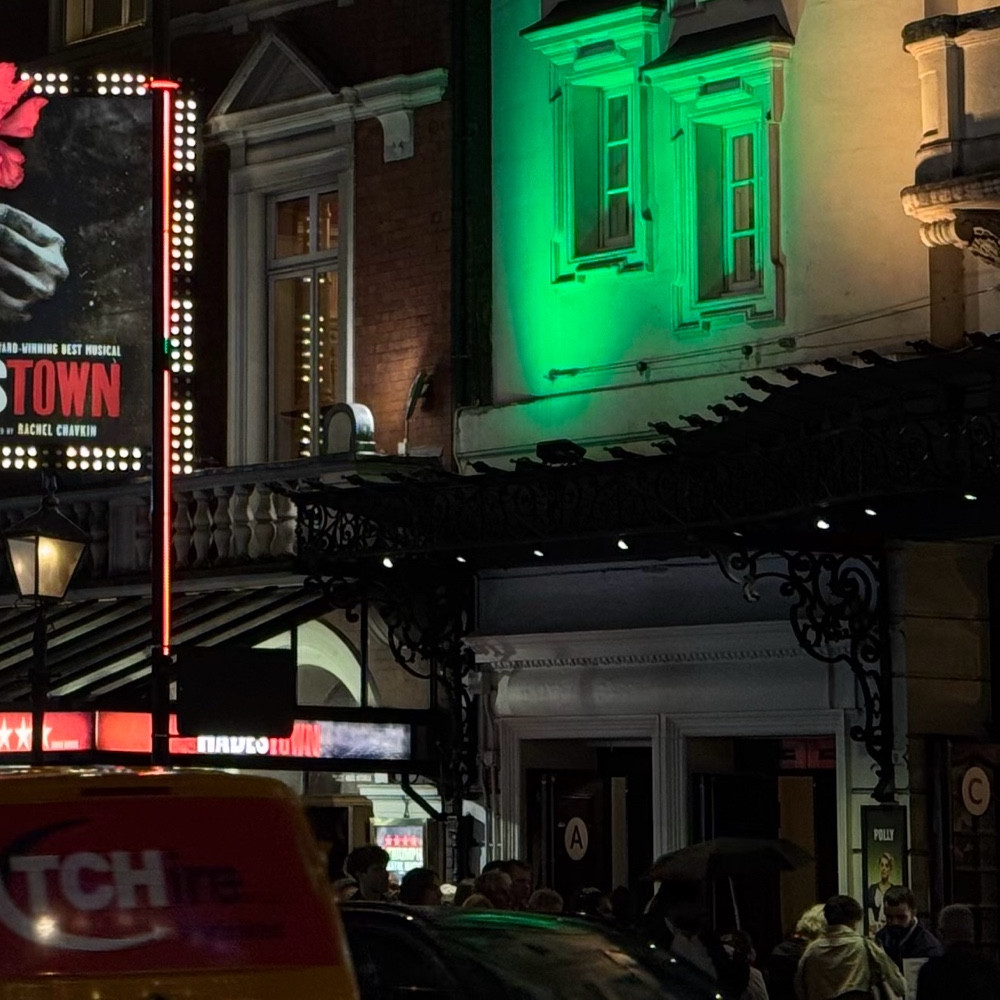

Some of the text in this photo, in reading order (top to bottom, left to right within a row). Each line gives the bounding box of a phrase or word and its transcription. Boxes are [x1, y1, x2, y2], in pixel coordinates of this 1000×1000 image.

[61, 343, 82, 356] BEST
[85, 344, 121, 357] MUSICAL
[17, 422, 53, 437] RACHEL
[56, 423, 97, 438] CHAVKIN
[968, 778, 983, 805] C
[570, 824, 583, 849] A
[873, 828, 895, 841] POLLY
